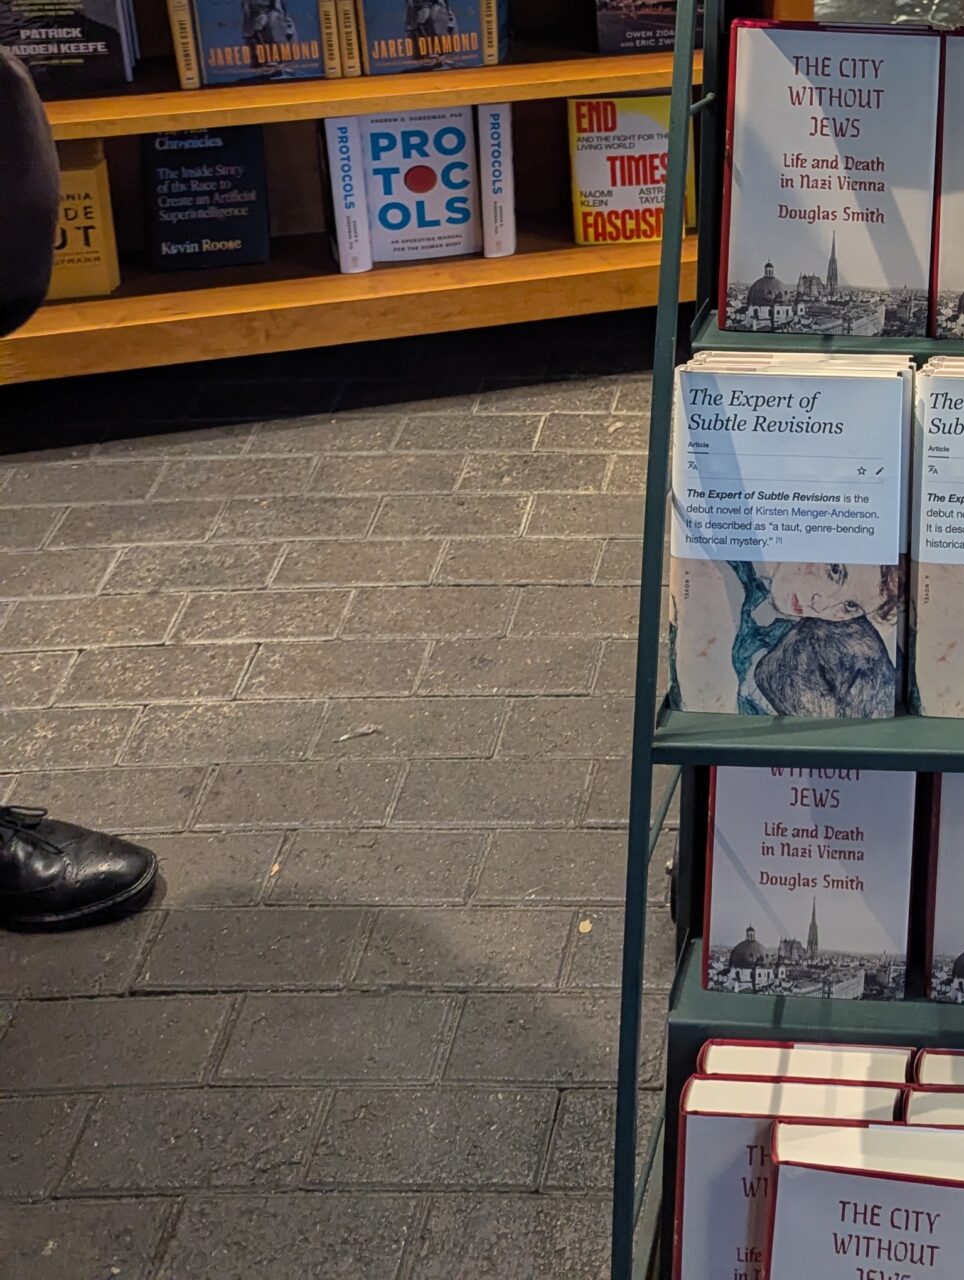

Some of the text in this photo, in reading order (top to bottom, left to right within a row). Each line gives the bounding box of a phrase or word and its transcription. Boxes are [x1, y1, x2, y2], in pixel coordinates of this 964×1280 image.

[20, 28, 82, 39] PATRICK
[371, 31, 479, 60] JARED DIAMOND
[208, 39, 319, 67] JARED DIAMOND
[575, 101, 617, 133] END
[370, 126, 467, 161] PRO
[337, 127, 355, 210] PROTOCOLS
[378, 196, 471, 231] OLS
[930, 392, 964, 410] The
[927, 493, 946, 503] The
[926, 508, 954, 518] debut
[926, 524, 933, 532] It
[935, 524, 942, 533] is
[838, 1199, 942, 1234] THE CITY
[832, 1232, 941, 1268] WITHOUT
